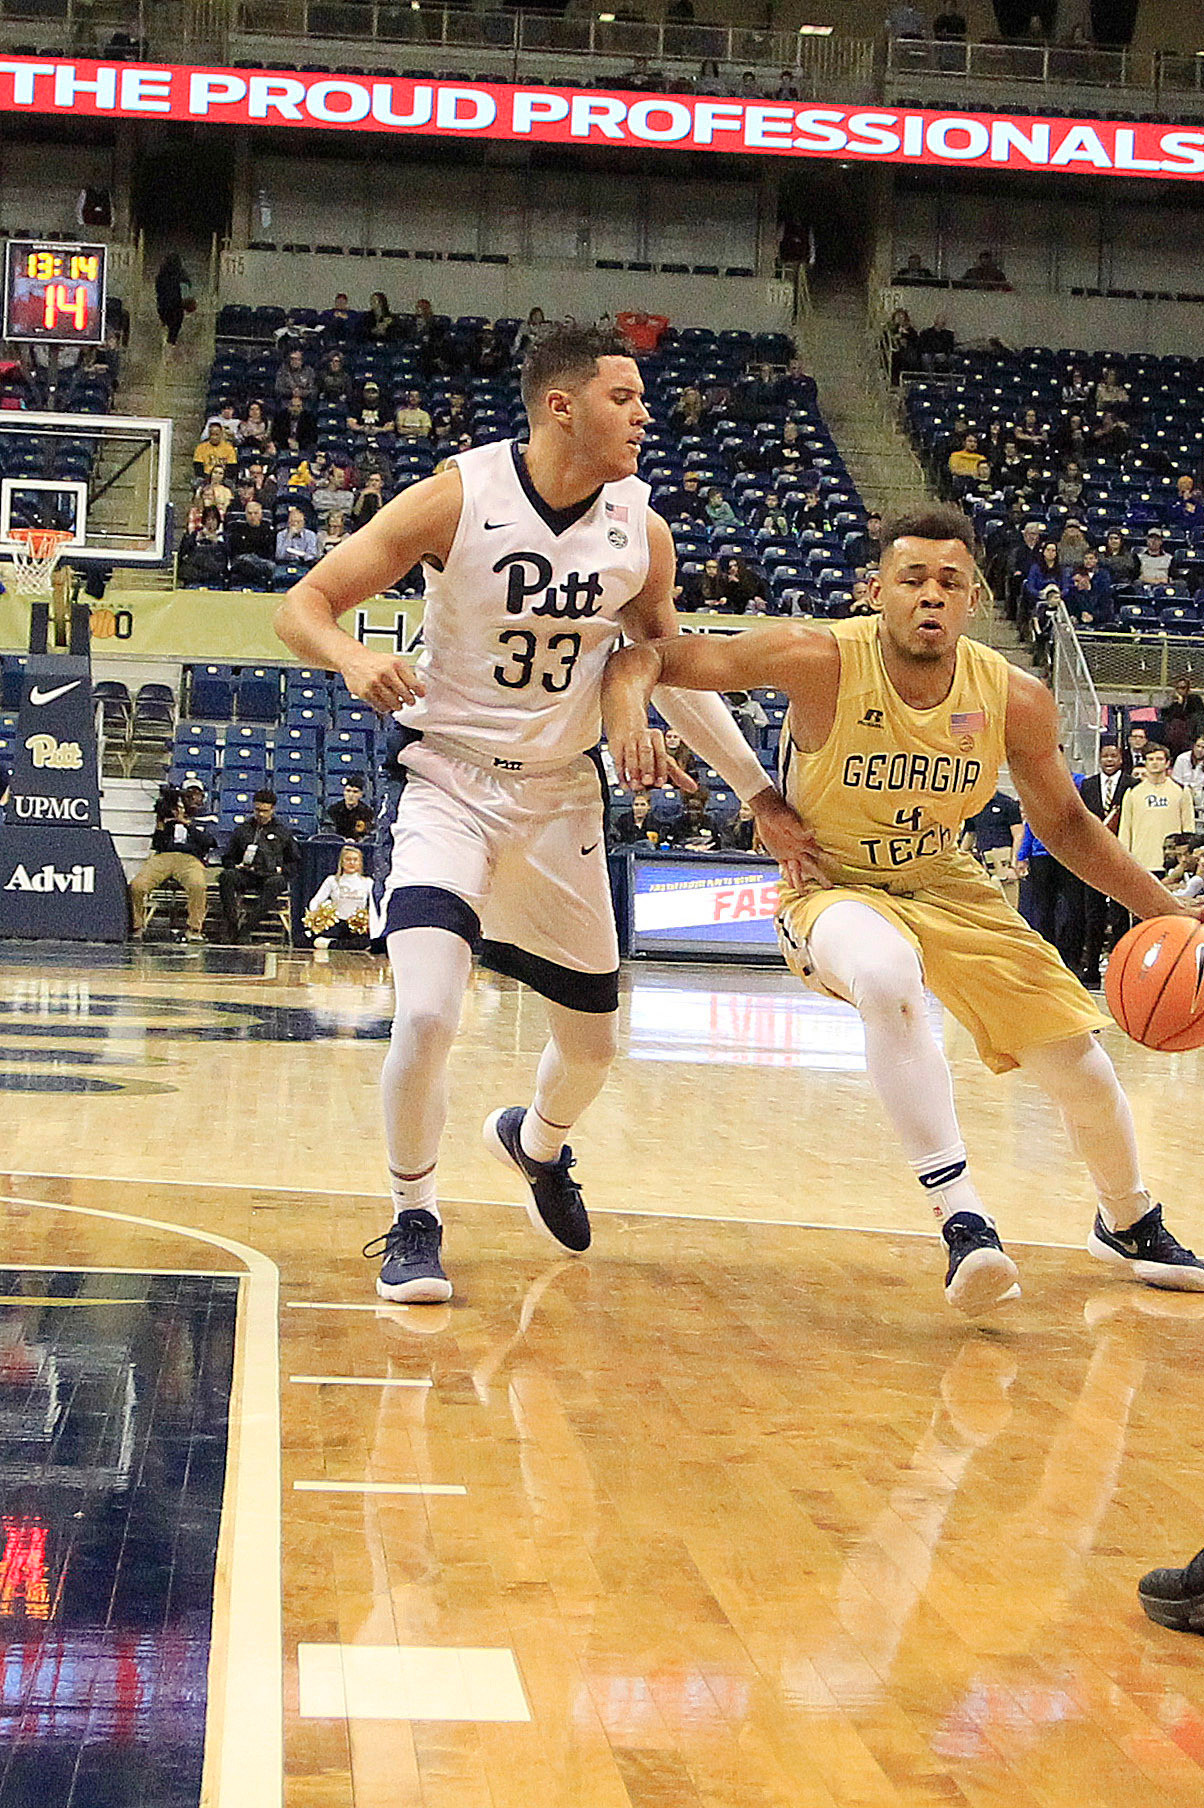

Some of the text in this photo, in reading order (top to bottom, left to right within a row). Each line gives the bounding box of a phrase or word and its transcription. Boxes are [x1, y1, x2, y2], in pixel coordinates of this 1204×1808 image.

[0, 62, 172, 113] THE
[189, 72, 497, 130] PROUD
[27, 253, 98, 281] 13:14
[43, 283, 89, 331] 14
[492, 551, 604, 620] Pitt
[494, 629, 582, 694] 33
[25, 733, 84, 770] Pitt
[843, 753, 982, 794] GEORGIA
[14, 795, 90, 821] UPMC
[894, 805, 924, 832] 4
[3, 864, 96, 894] Advil
